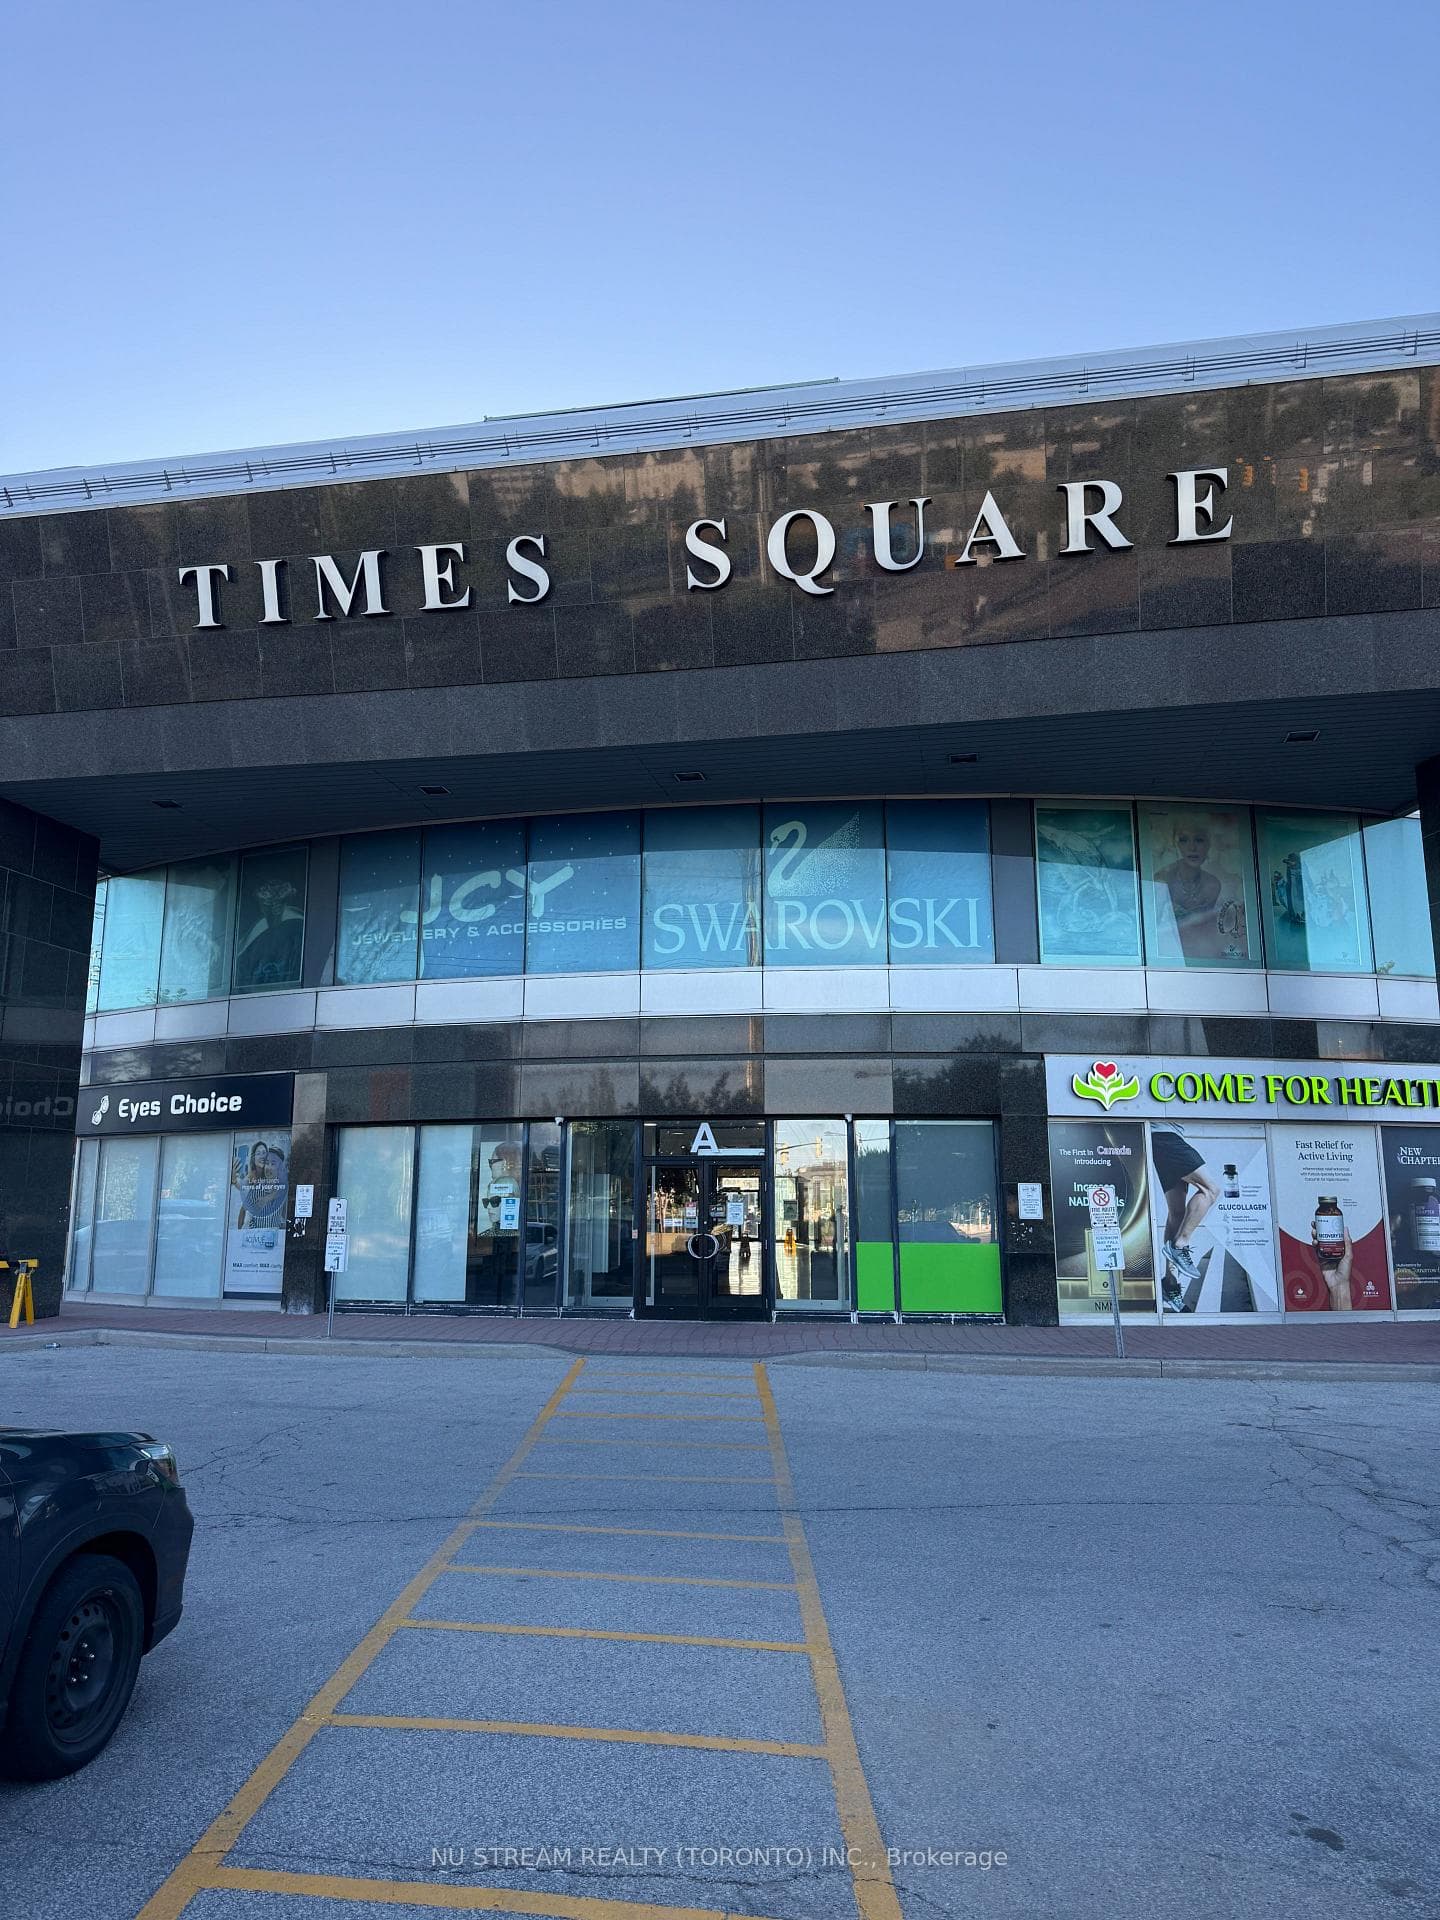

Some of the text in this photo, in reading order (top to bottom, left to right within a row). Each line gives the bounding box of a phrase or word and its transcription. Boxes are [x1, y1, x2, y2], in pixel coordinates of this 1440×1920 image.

[178, 467, 1234, 629] TIMES SQUARE
[399, 866, 575, 925] JCY
[351, 916, 628, 946] JEWELLERY & ACCESSORIES
[652, 897, 982, 954] SWAROVSKI
[1149, 1071, 1257, 1103] COME
[1263, 1074, 1333, 1105] FOR
[118, 1091, 243, 1123] Eyes Choice
[690, 1122, 720, 1153] A
[1059, 1148, 1072, 1156] The
[1072, 1148, 1087, 1156] First
[1097, 1145, 1132, 1156] Canada
[1295, 1140, 1354, 1150] Fast Relief for
[1074, 1158, 1111, 1167] Introducing
[1297, 1151, 1354, 1163] Active Living
